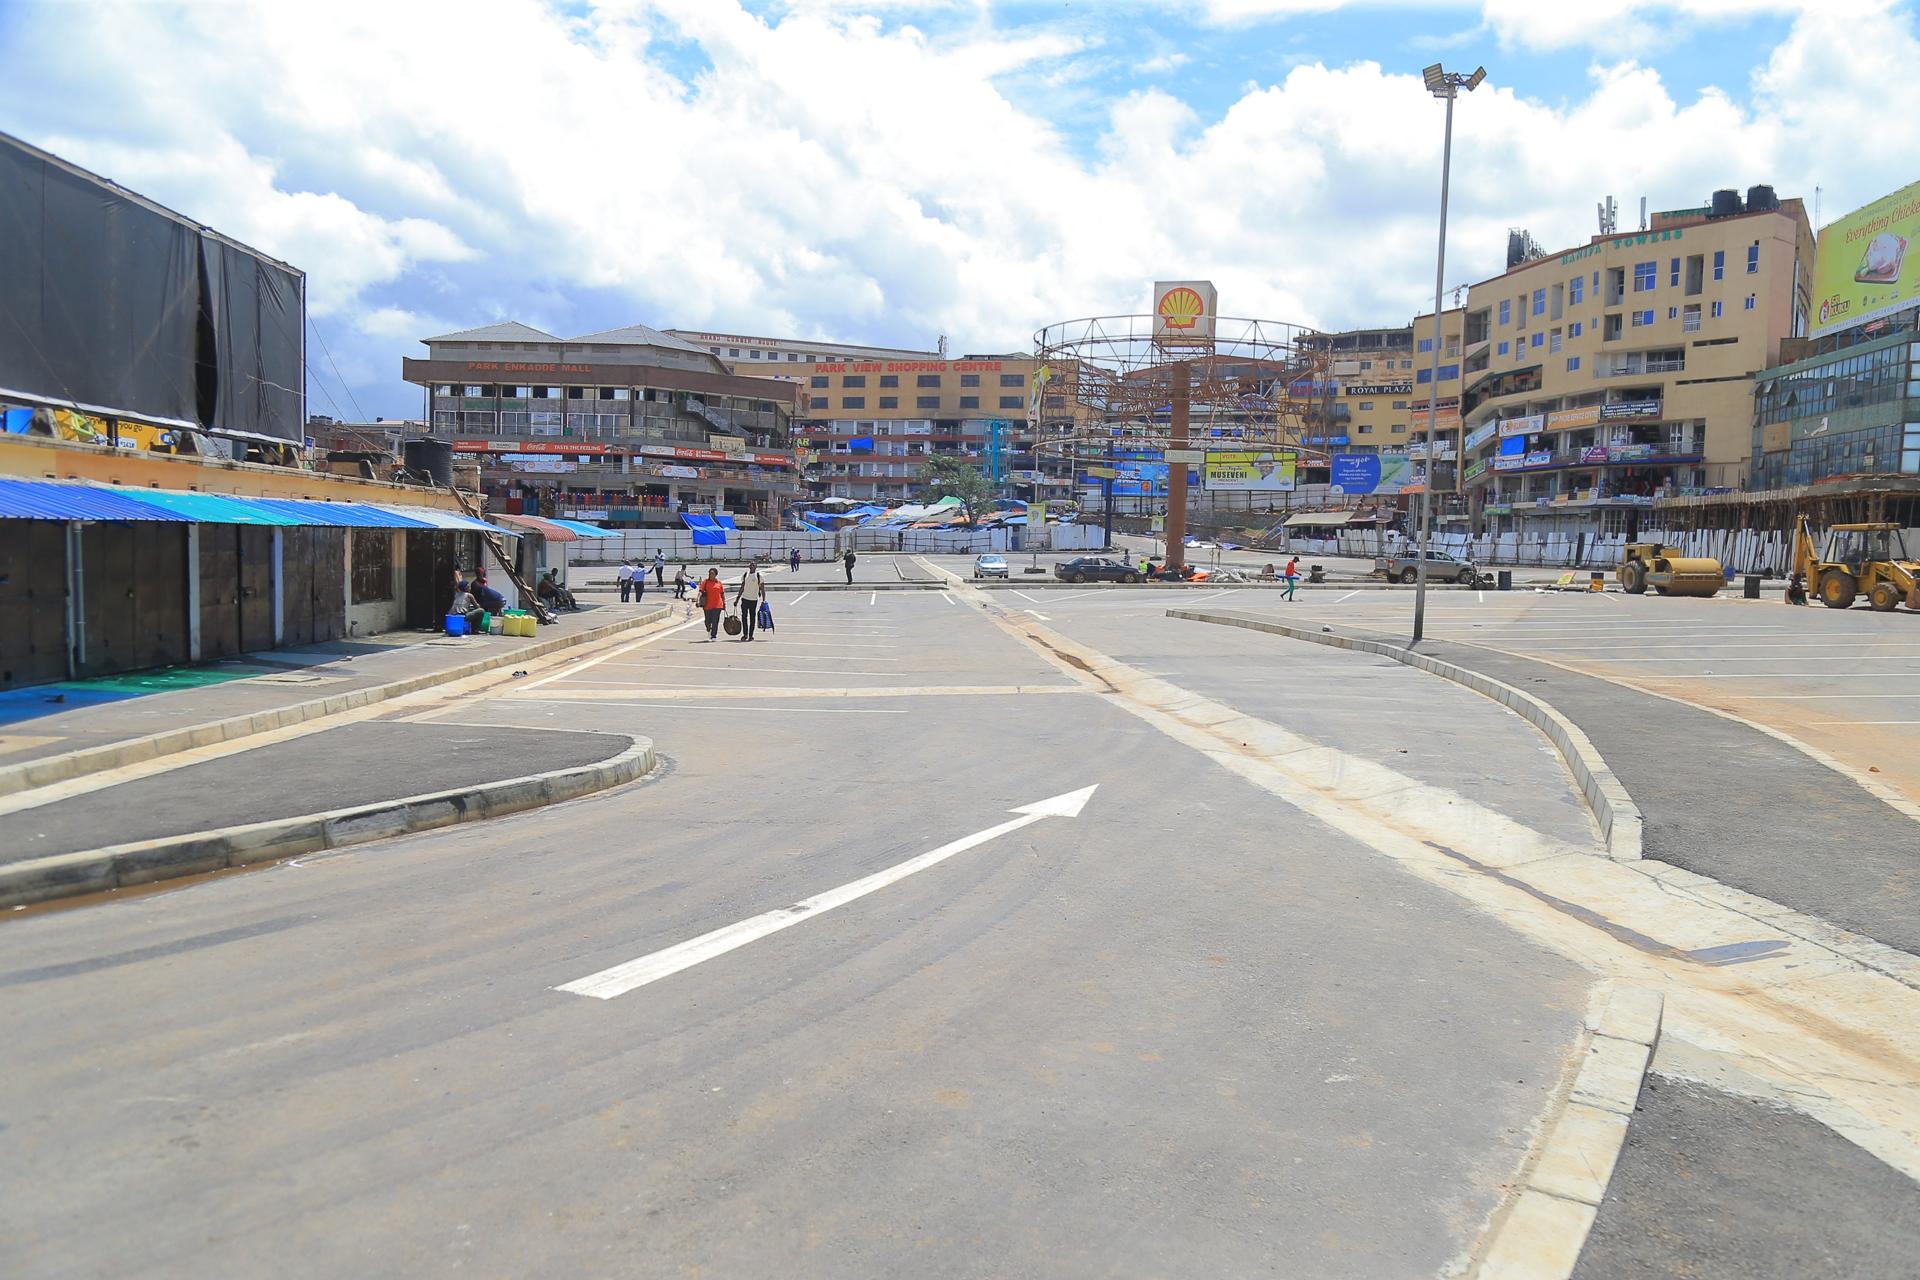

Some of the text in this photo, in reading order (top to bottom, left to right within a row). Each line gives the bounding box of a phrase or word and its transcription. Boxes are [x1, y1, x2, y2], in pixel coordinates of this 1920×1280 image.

[1613, 229, 1684, 250] TOWERS
[468, 362, 499, 371] PARK
[561, 364, 592, 373] MALL
[816, 361, 1003, 373] PARK VIEW SHOPPING CENTRE
[1351, 386, 1412, 395] ROYAL PLAZA
[133, 425, 143, 433] go
[1210, 471, 1247, 479] MUSEVENI
